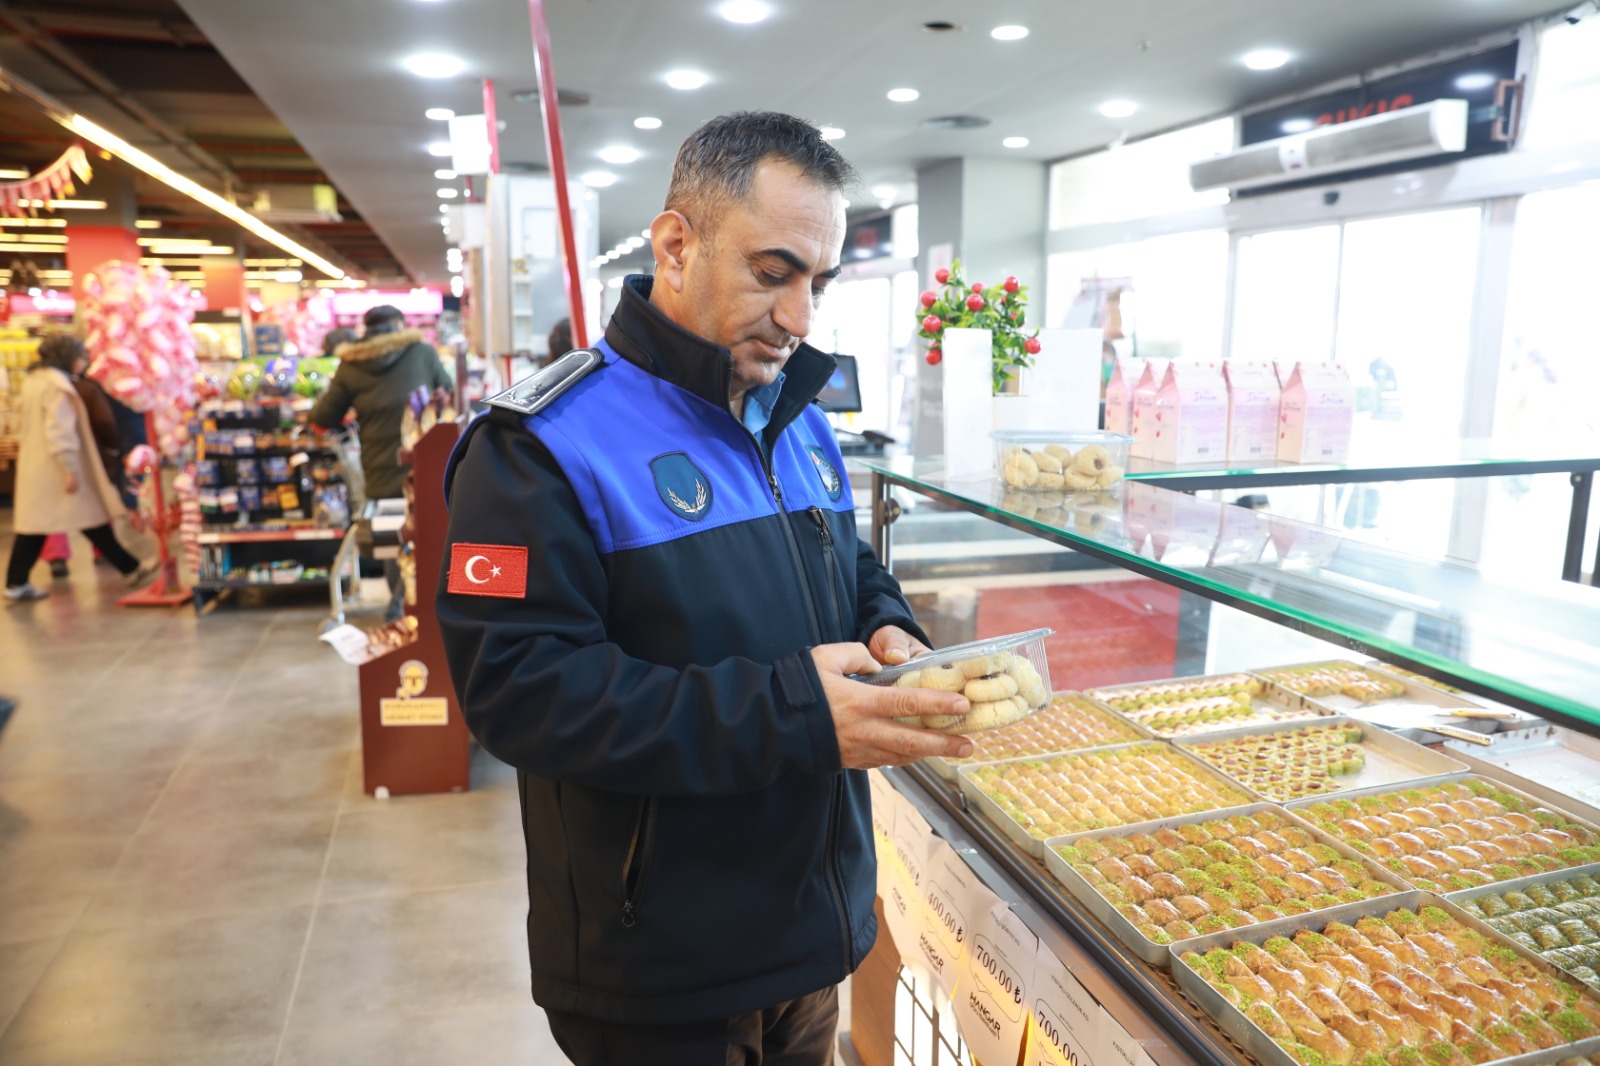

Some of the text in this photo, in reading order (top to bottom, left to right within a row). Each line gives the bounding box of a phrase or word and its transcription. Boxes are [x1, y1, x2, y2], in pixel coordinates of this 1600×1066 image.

[928, 892, 956, 933] 400.00
[920, 932, 944, 975] HANGAR
[977, 944, 1012, 994] 700.00
[970, 991, 1001, 1040] HANGAR
[1038, 1010, 1078, 1066] 700.00
